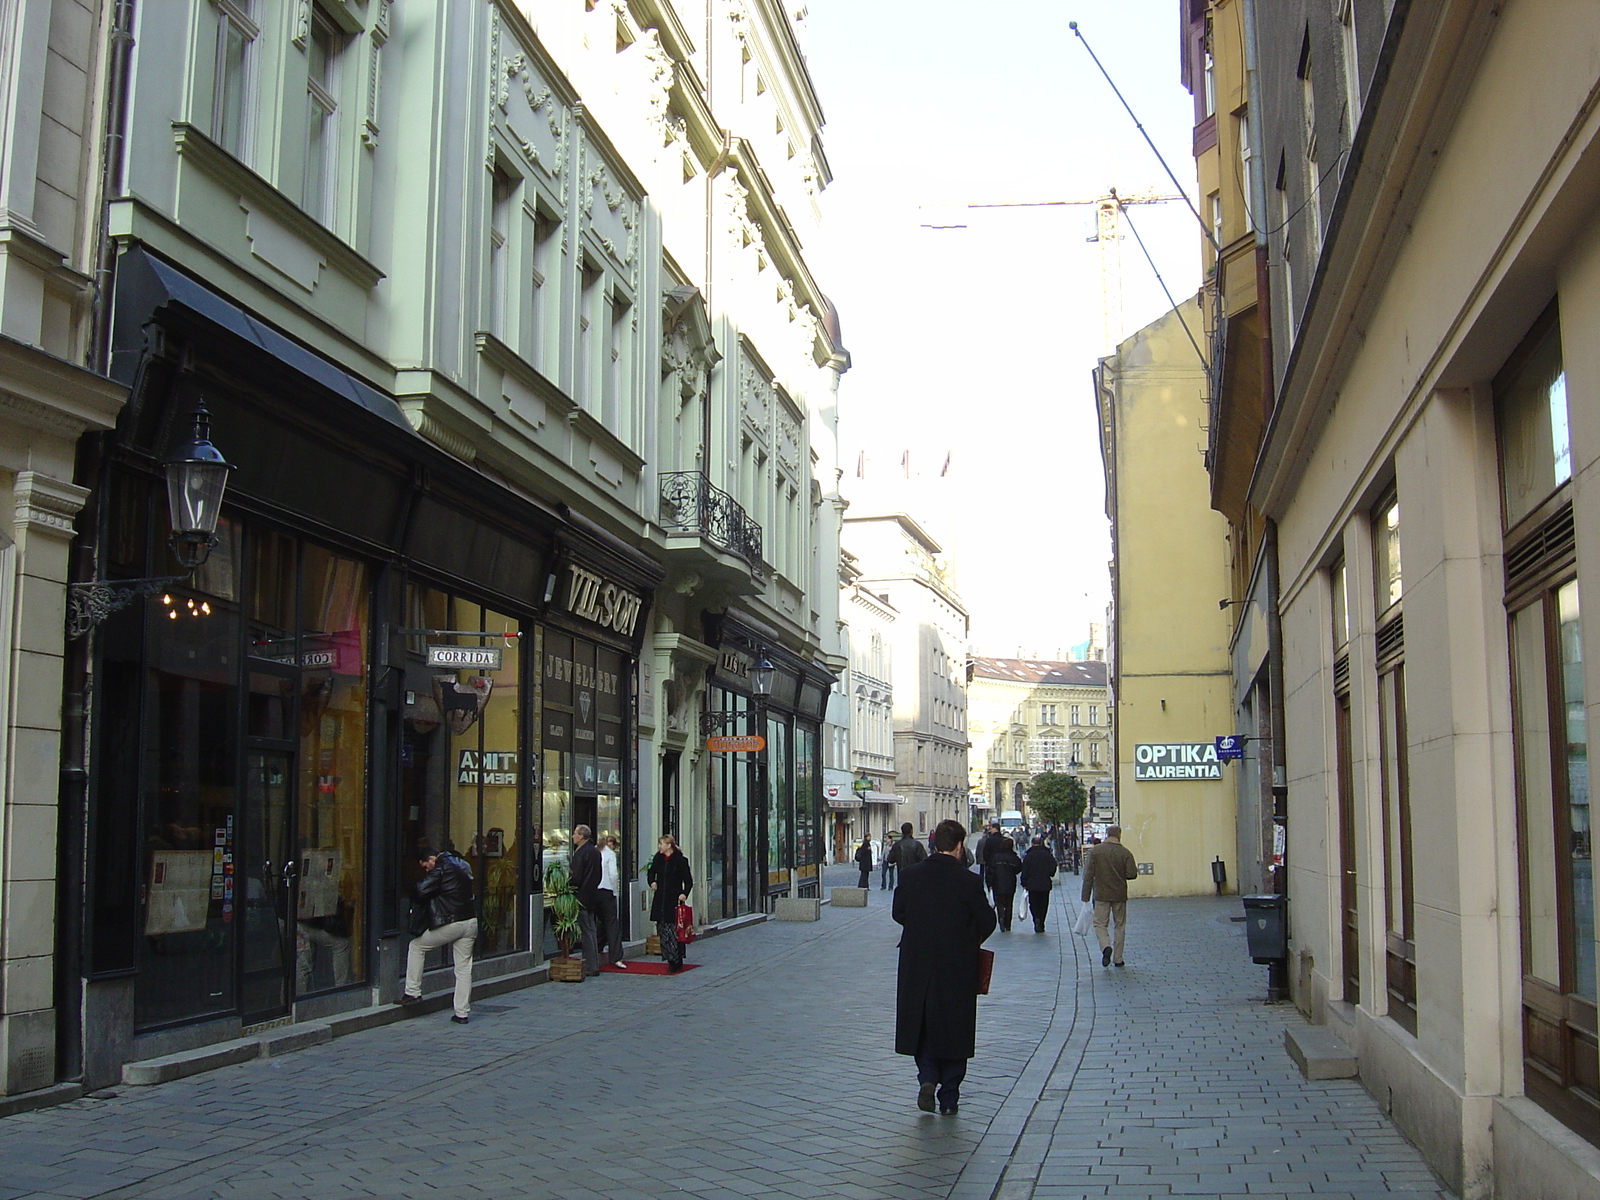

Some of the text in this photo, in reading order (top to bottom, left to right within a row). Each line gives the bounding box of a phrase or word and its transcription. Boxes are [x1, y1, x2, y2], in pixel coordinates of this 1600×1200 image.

[568, 564, 643, 638] VILSON
[437, 651, 490, 664] CORRIDA
[546, 654, 618, 695] JEWELLERY
[1136, 744, 1220, 763] OPTIKA
[1136, 764, 1221, 778] LAURENTIA
